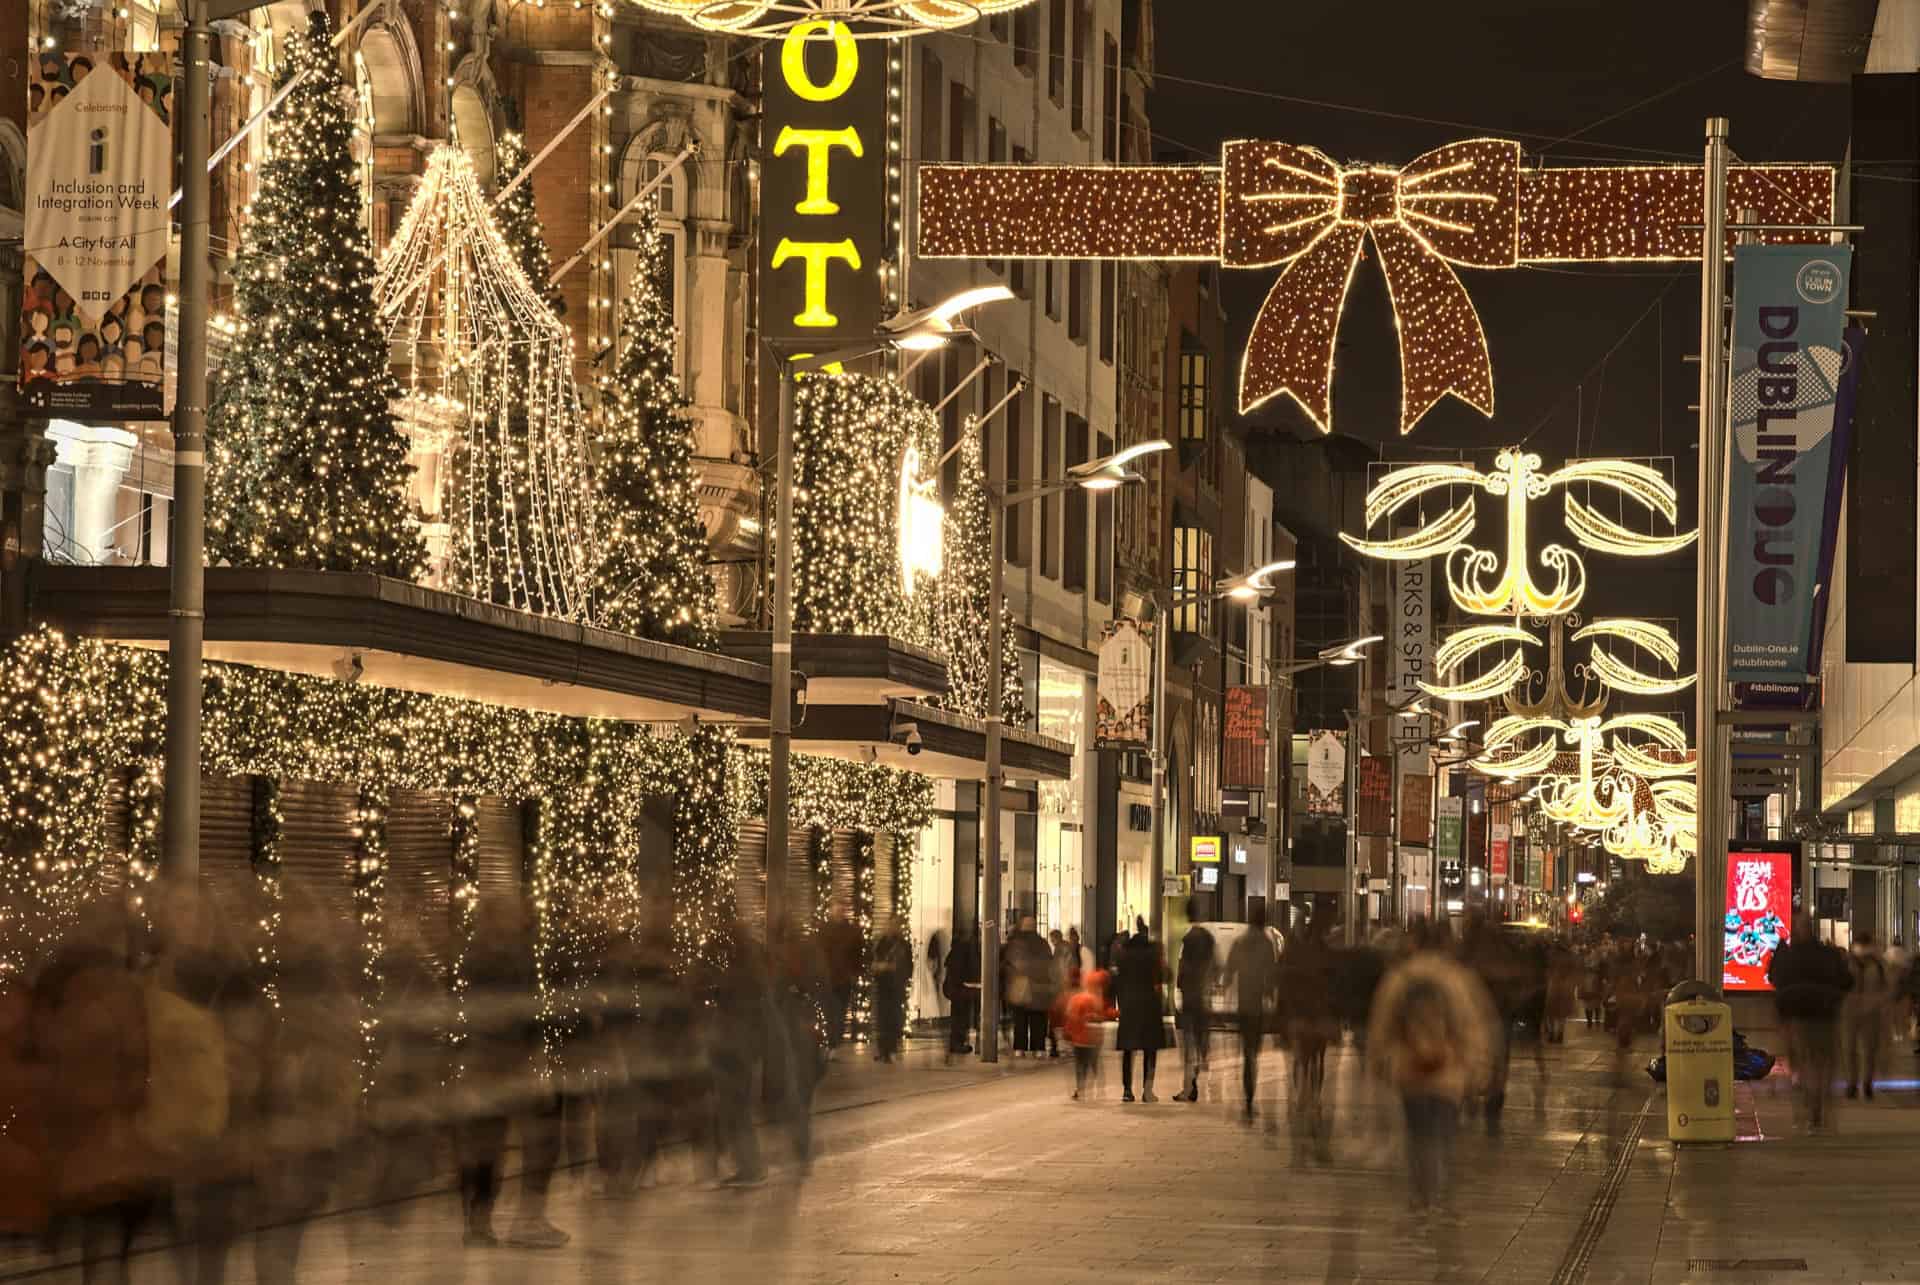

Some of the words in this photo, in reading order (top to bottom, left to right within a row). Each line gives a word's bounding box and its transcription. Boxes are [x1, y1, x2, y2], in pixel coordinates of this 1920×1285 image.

[74, 102, 128, 114] Celebrating
[52, 178, 114, 193] Inclusion
[117, 179, 145, 193] and
[37, 194, 113, 212] Integration
[118, 194, 160, 209] Week
[58, 235, 69, 248] A
[72, 235, 96, 251] City
[99, 235, 117, 248] for
[119, 235, 136, 249] All
[75, 255, 87, 265] 12
[1403, 558, 1423, 617] ARKS
[1403, 622, 1422, 638] &
[1733, 658, 1787, 668] #dublinone
[1750, 683, 1799, 693] #dublinone
[1736, 860, 1773, 881] TEAM
[1735, 883, 1770, 912] US
